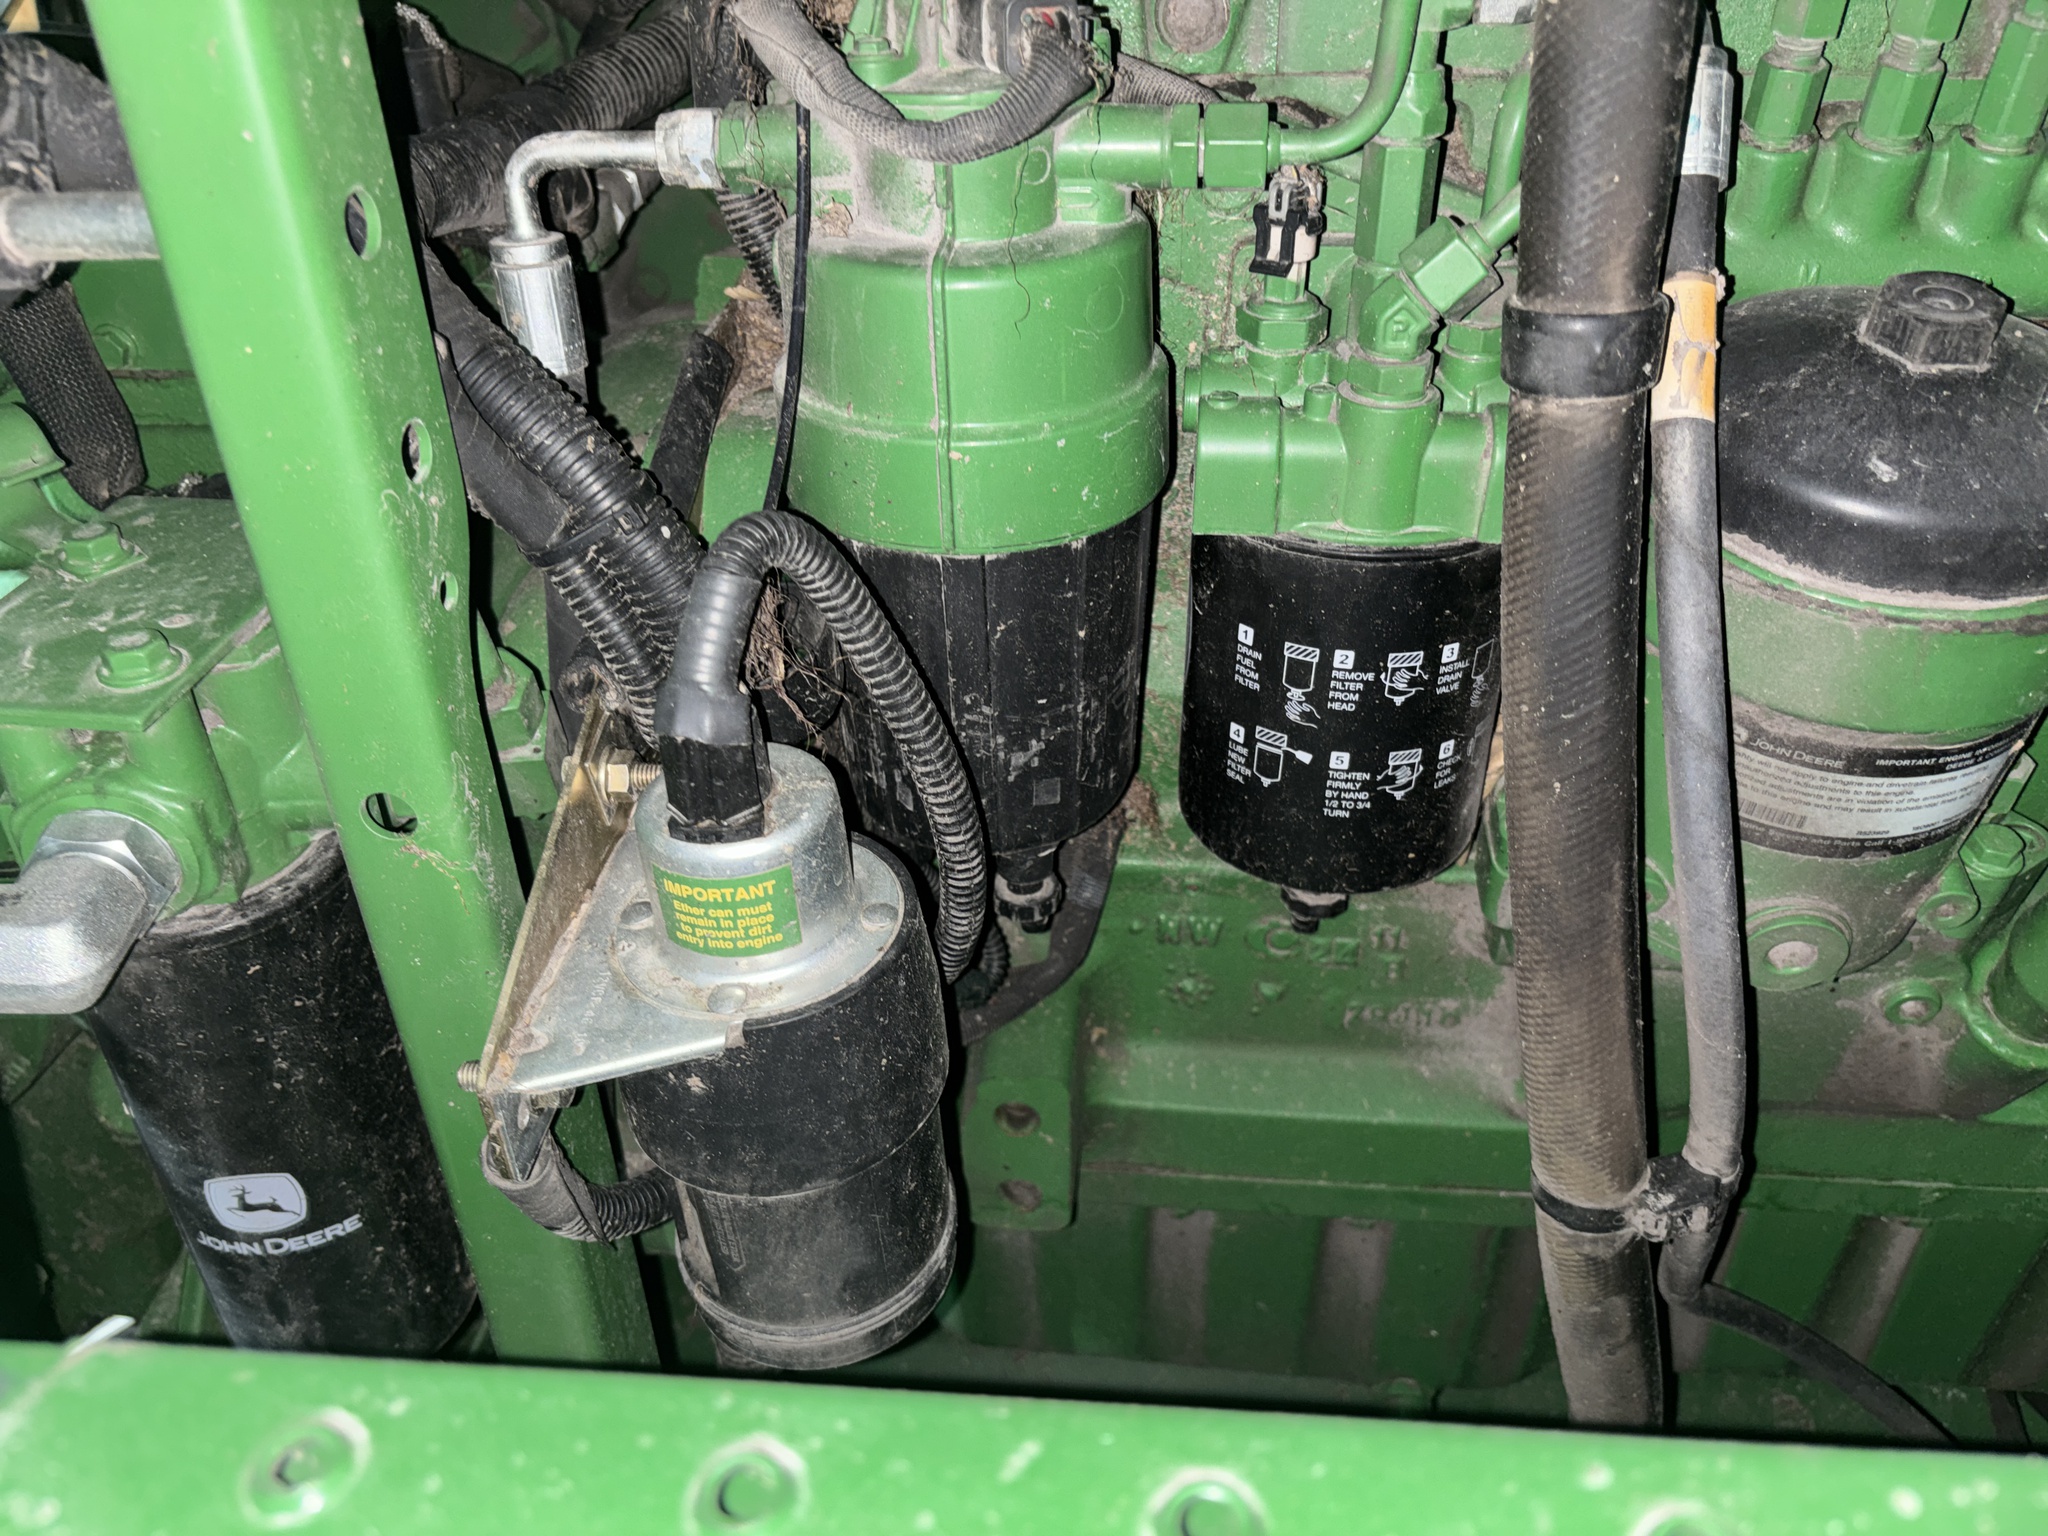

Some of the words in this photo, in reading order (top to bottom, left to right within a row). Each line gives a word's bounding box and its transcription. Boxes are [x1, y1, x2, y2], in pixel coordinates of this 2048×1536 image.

[1237, 643, 1262, 661] DRAIN
[1236, 654, 1256, 670] FUEL
[1439, 659, 1470, 674] INSTALL
[1235, 663, 1259, 681] FROM
[1331, 670, 1376, 681] REMOVE
[1437, 670, 1463, 685] DRAIN
[1234, 673, 1260, 692] FILTER
[1330, 680, 1364, 691] FILTER
[1435, 681, 1460, 695] VALVE
[1329, 691, 1359, 701] FROM
[1327, 701, 1356, 711] HEAD
[1228, 740, 1249, 757] LUBE
[1750, 738, 1792, 757] JOHN
[1793, 750, 1846, 769] DEERE
[1227, 750, 1246, 764] NEW
[1437, 753, 1461, 770] CHECK
[1875, 757, 1937, 766] IMPORTANT
[1938, 751, 1974, 764] ENGINE
[1945, 757, 1976, 771] DEERE
[1227, 759, 1251, 777] FILTER
[1328, 770, 1370, 781] TIGHTEN
[1435, 767, 1451, 780] FOR
[1757, 758, 1772, 768] will
[1774, 765, 1789, 774] not
[1791, 769, 1817, 781] apply
[1819, 775, 1829, 783] to
[1831, 779, 1864, 787] engine
[1226, 768, 1245, 785] SEAL
[1433, 773, 1457, 789] LEAKS
[1326, 780, 1362, 790] FIRMLY
[1793, 780, 1850, 795] adjustments
[1325, 789, 1339, 798] BY
[1340, 791, 1369, 800] HAND
[1325, 799, 1339, 808] 1/2
[1341, 800, 1355, 809] TO
[1356, 801, 1371, 810] 3/4
[1323, 808, 1350, 818] TURN
[1833, 838, 1861, 846] Parts
[1864, 839, 1885, 847] Call
[663, 878, 776, 902] IMPORTANT
[673, 899, 706, 917] Ether
[708, 908, 734, 918] can
[736, 901, 773, 917] must
[675, 912, 717, 928] remain
[719, 918, 734, 928] in
[737, 914, 775, 930] place
[680, 922, 693, 933] to
[695, 927, 745, 939] prevent
[748, 924, 773, 937] dirt
[676, 931, 705, 948] entry
[707, 938, 734, 949] into
[736, 933, 783, 949] engine
[197, 1230, 263, 1256] JOHN
[263, 1213, 364, 1255] DEERE
